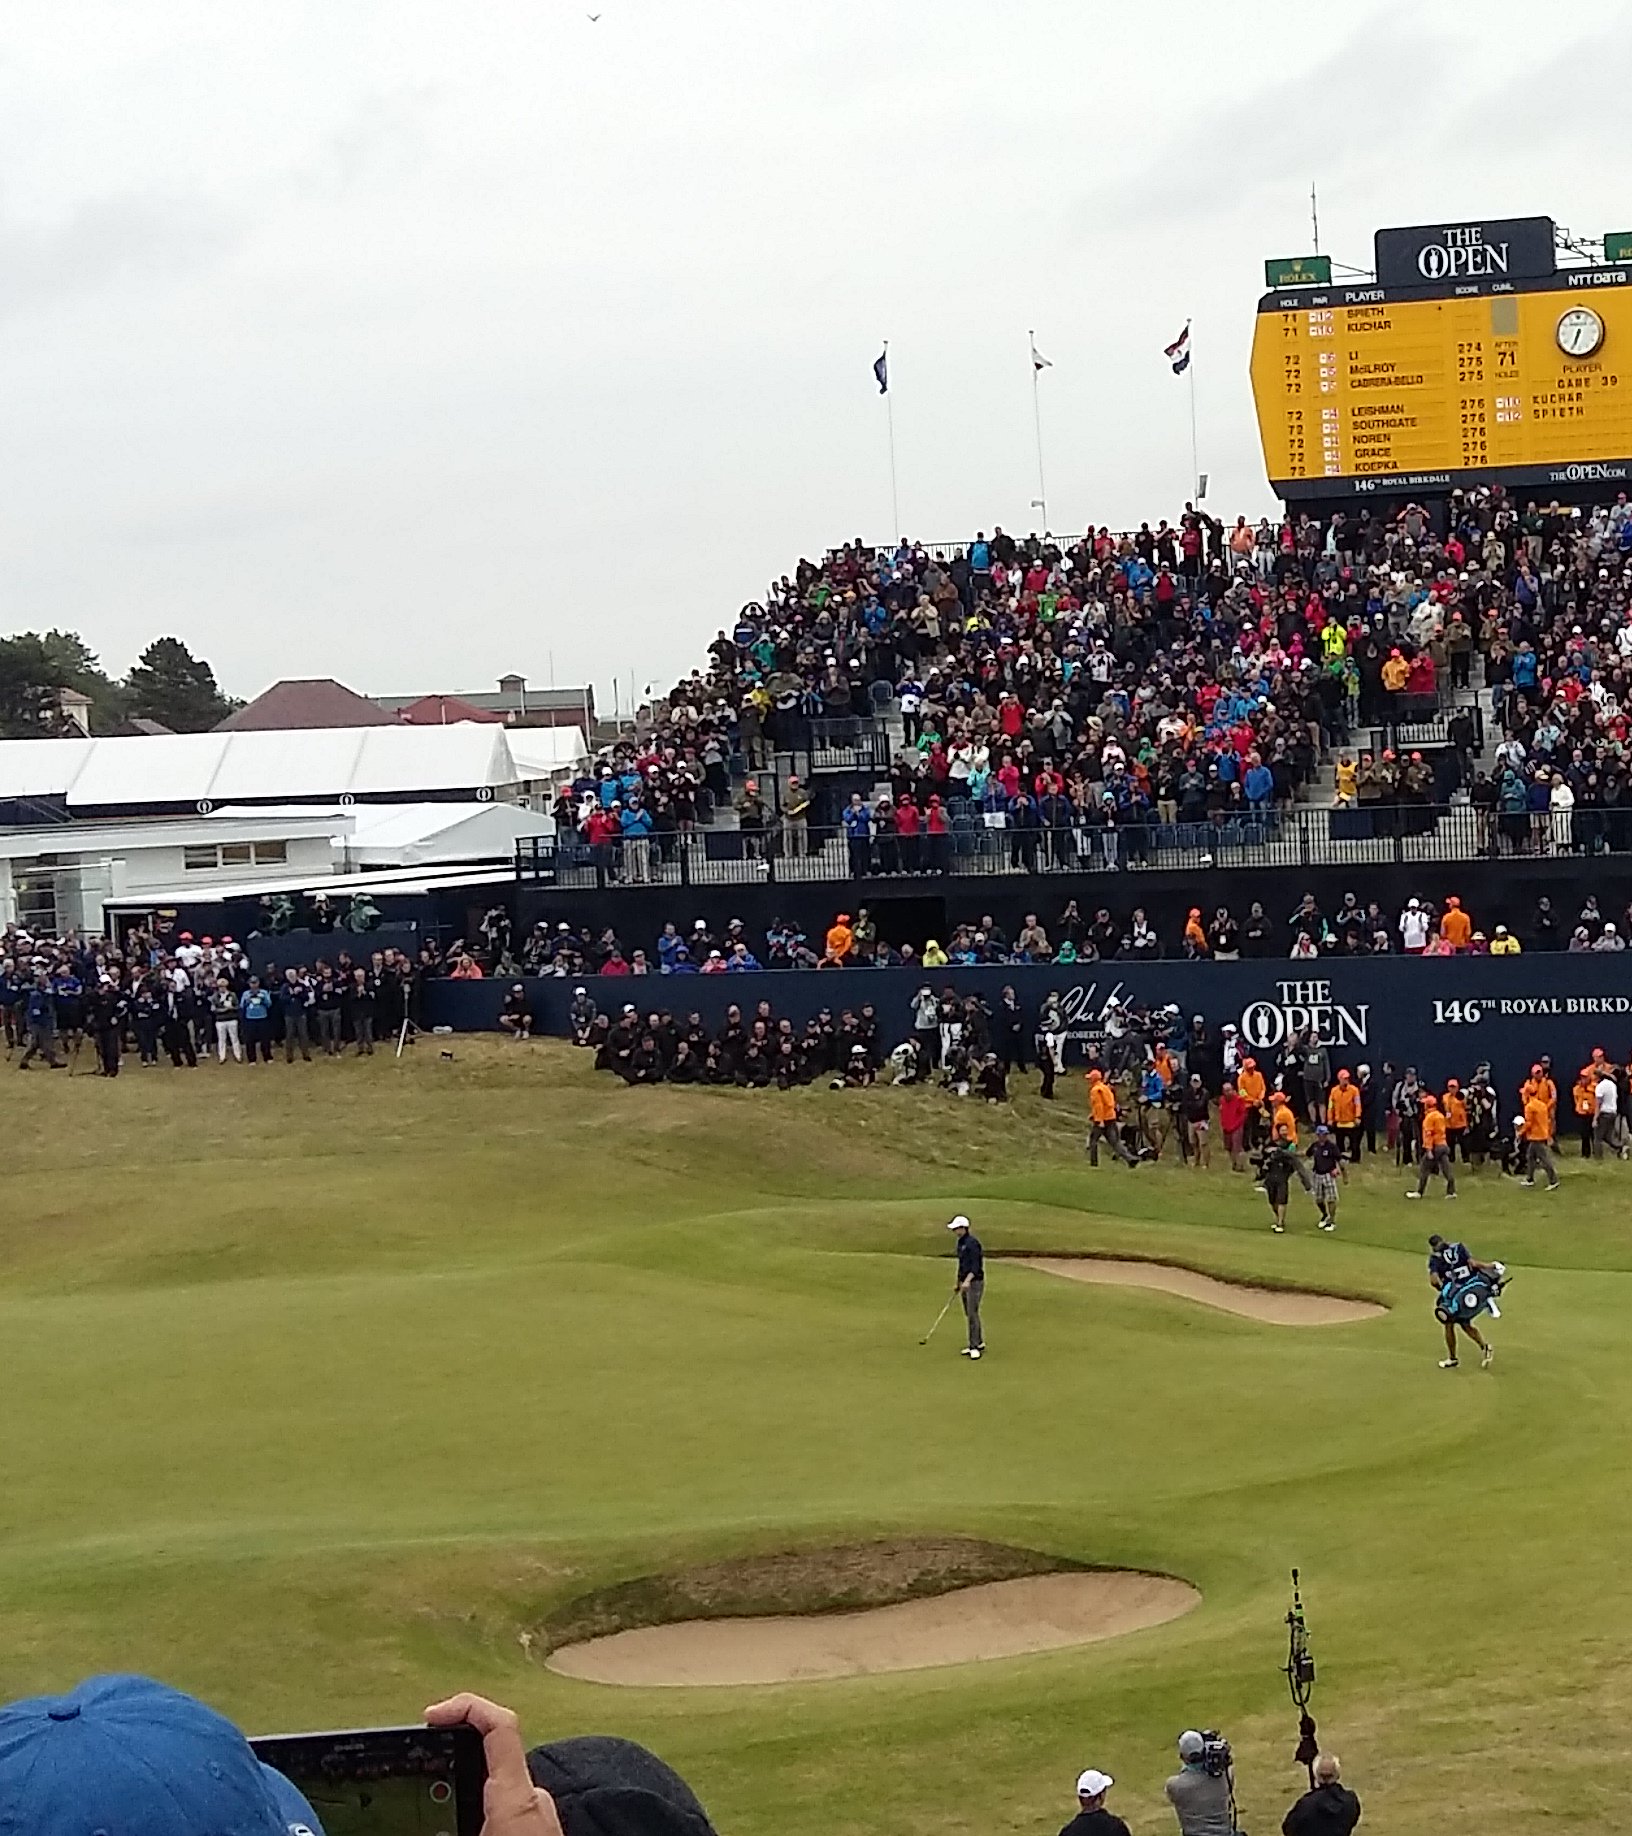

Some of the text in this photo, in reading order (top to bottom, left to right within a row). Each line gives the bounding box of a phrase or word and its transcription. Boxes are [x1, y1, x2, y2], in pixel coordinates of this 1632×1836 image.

[1443, 227, 1483, 247] THE
[1418, 242, 1510, 279] OPEN
[1345, 290, 1385, 303] PLAYER
[1282, 313, 1297, 324] 71
[1347, 307, 1385, 319] SPIETH
[1282, 327, 1298, 338] 71
[1347, 320, 1392, 333] KUCHAR
[1285, 355, 1301, 365] 72
[1349, 350, 1359, 361] LI
[1458, 342, 1482, 353] 274
[1495, 341, 1519, 349] AFTER
[1285, 369, 1301, 380] 72
[1459, 356, 1483, 368] 275
[1498, 351, 1516, 367] 71
[1563, 363, 1602, 375] PLAYER
[1286, 383, 1302, 394] 72
[1459, 370, 1483, 382] 275
[1557, 375, 1618, 389] GAME 39
[1287, 411, 1303, 421] 72
[1352, 404, 1404, 417] LEISHMAN
[1461, 398, 1485, 410] 276
[1533, 392, 1584, 405] KUCHAR
[1288, 425, 1304, 435] 72
[1352, 417, 1417, 430] SOUTHGATE
[1461, 412, 1486, 424] 276
[1533, 407, 1585, 420] SPIETH
[1289, 439, 1304, 449] 72
[1353, 433, 1391, 445] NOREN
[1462, 427, 1486, 438] 276
[1289, 453, 1305, 463] 72
[1355, 447, 1391, 459] GRACE
[1463, 441, 1487, 452] 276
[1290, 466, 1306, 477] 72
[1355, 461, 1399, 473] KOEPKA
[1464, 455, 1488, 466] 276
[1382, 477, 1408, 486] ROYAL
[1409, 474, 1450, 485] BIRKDALE
[1275, 980, 1333, 1005] THE
[1432, 999, 1496, 1024] 146TH
[1500, 998, 1562, 1014] ROYAL
[1241, 1001, 1370, 1049] OPEN
